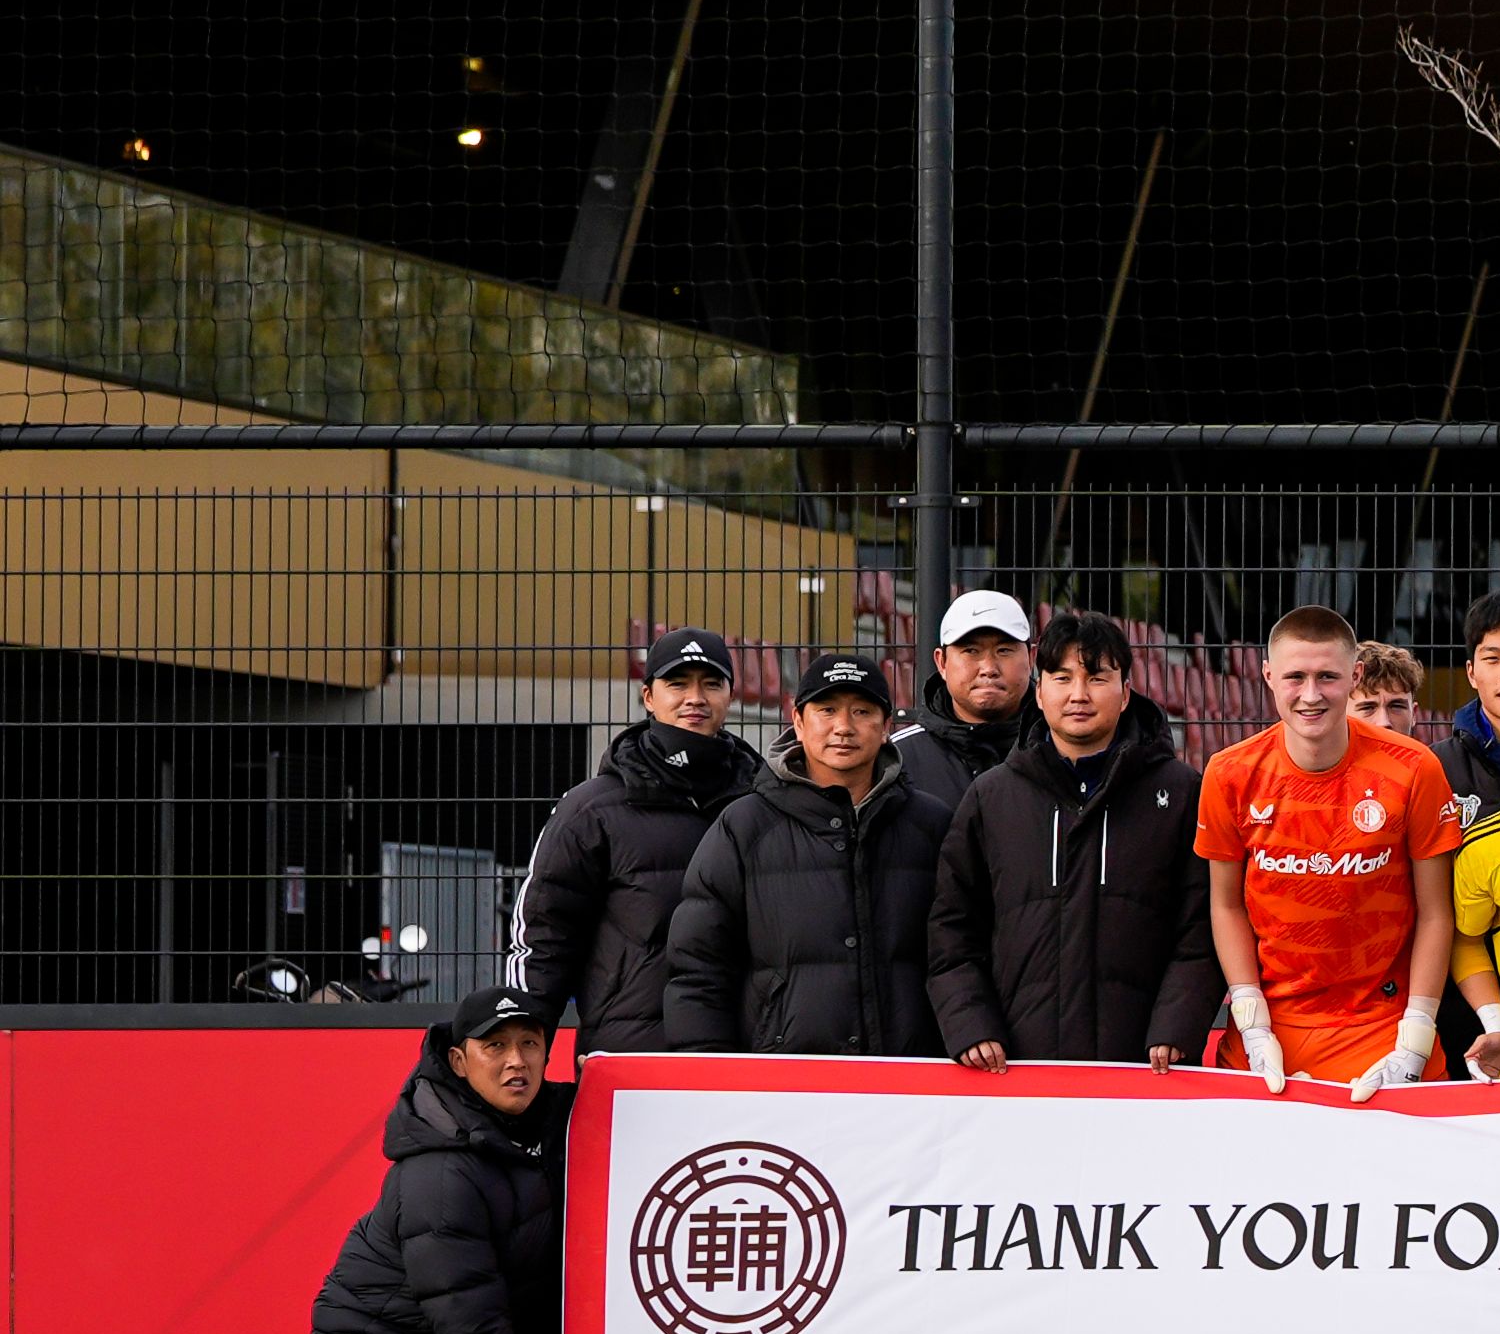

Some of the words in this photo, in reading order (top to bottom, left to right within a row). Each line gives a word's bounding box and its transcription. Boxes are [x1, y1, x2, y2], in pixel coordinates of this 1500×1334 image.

[1253, 846, 1308, 875] Media
[1330, 846, 1392, 876] Markt
[888, 1203, 1160, 1272] THANK
[1189, 1202, 1362, 1271] YOU
